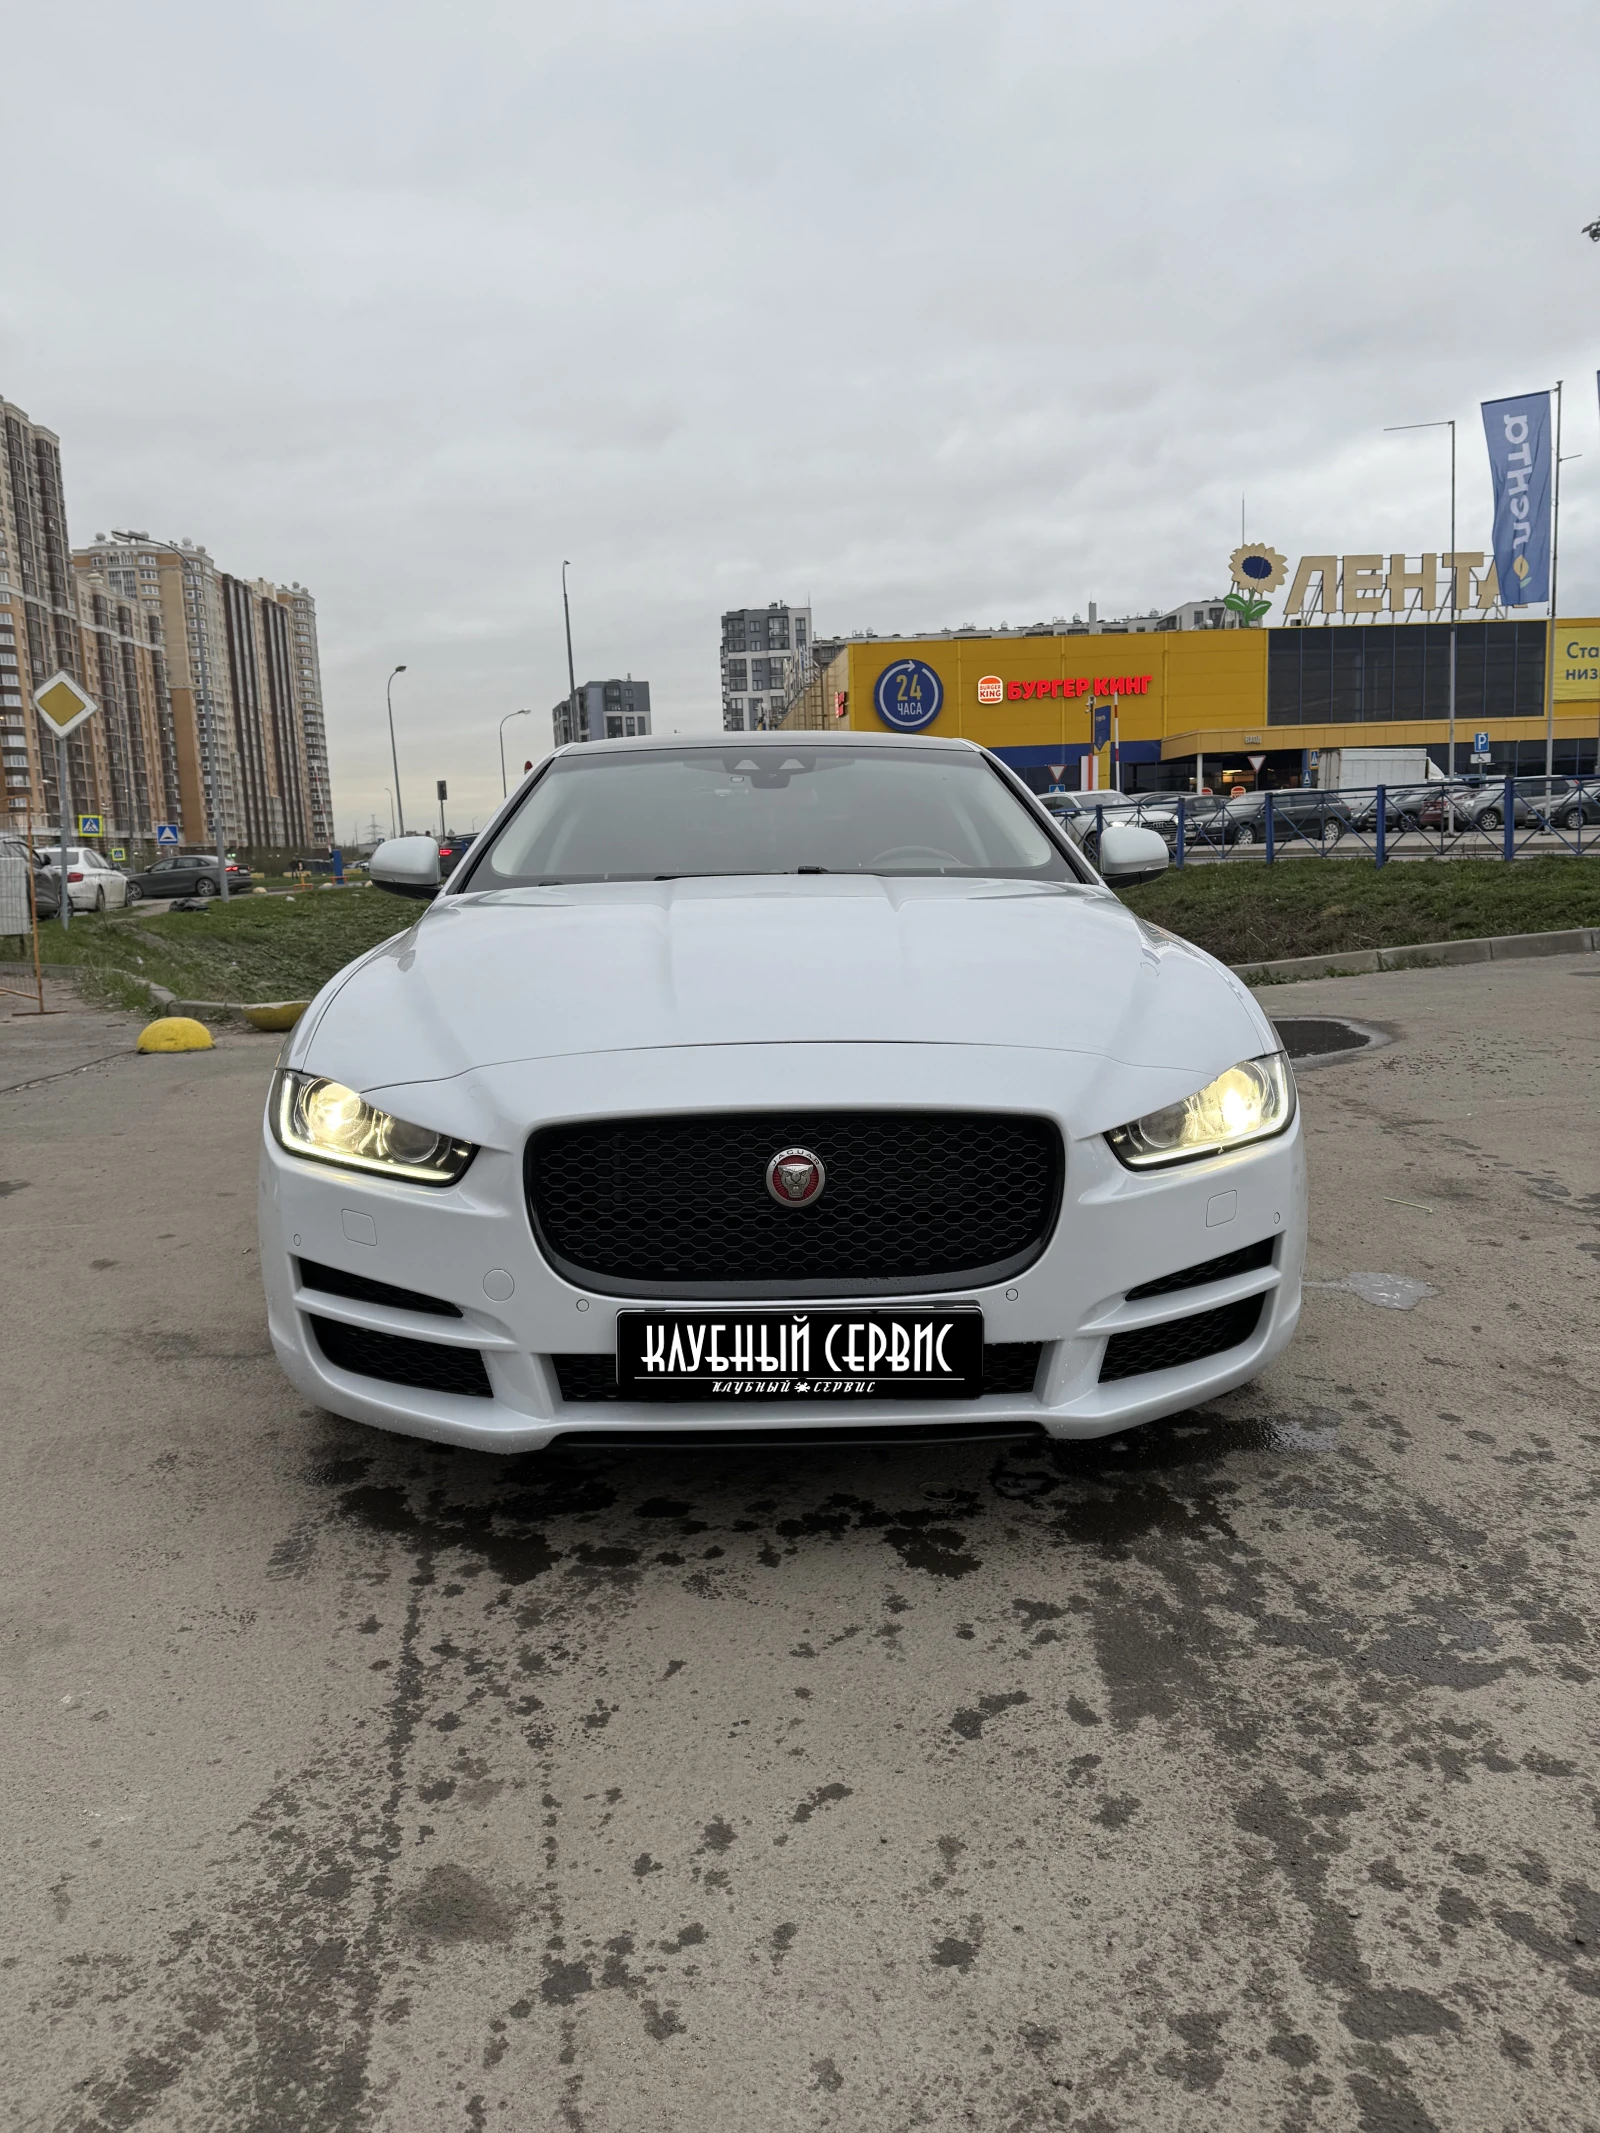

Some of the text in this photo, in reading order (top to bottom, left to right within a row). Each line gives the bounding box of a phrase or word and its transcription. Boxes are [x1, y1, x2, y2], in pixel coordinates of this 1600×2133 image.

[896, 674, 922, 701] 24
[979, 690, 1002, 698] KING
[1007, 675, 1153, 700] БУРГЕР КИНГ
[897, 702, 923, 715] ЧАСА
[772, 1149, 820, 1167] JAGUAR
[640, 1315, 954, 1372] КЛУБНЫЙ СЕРВИС
[712, 1380, 876, 1395] КЛУБНЫЙ СЕРВИС
